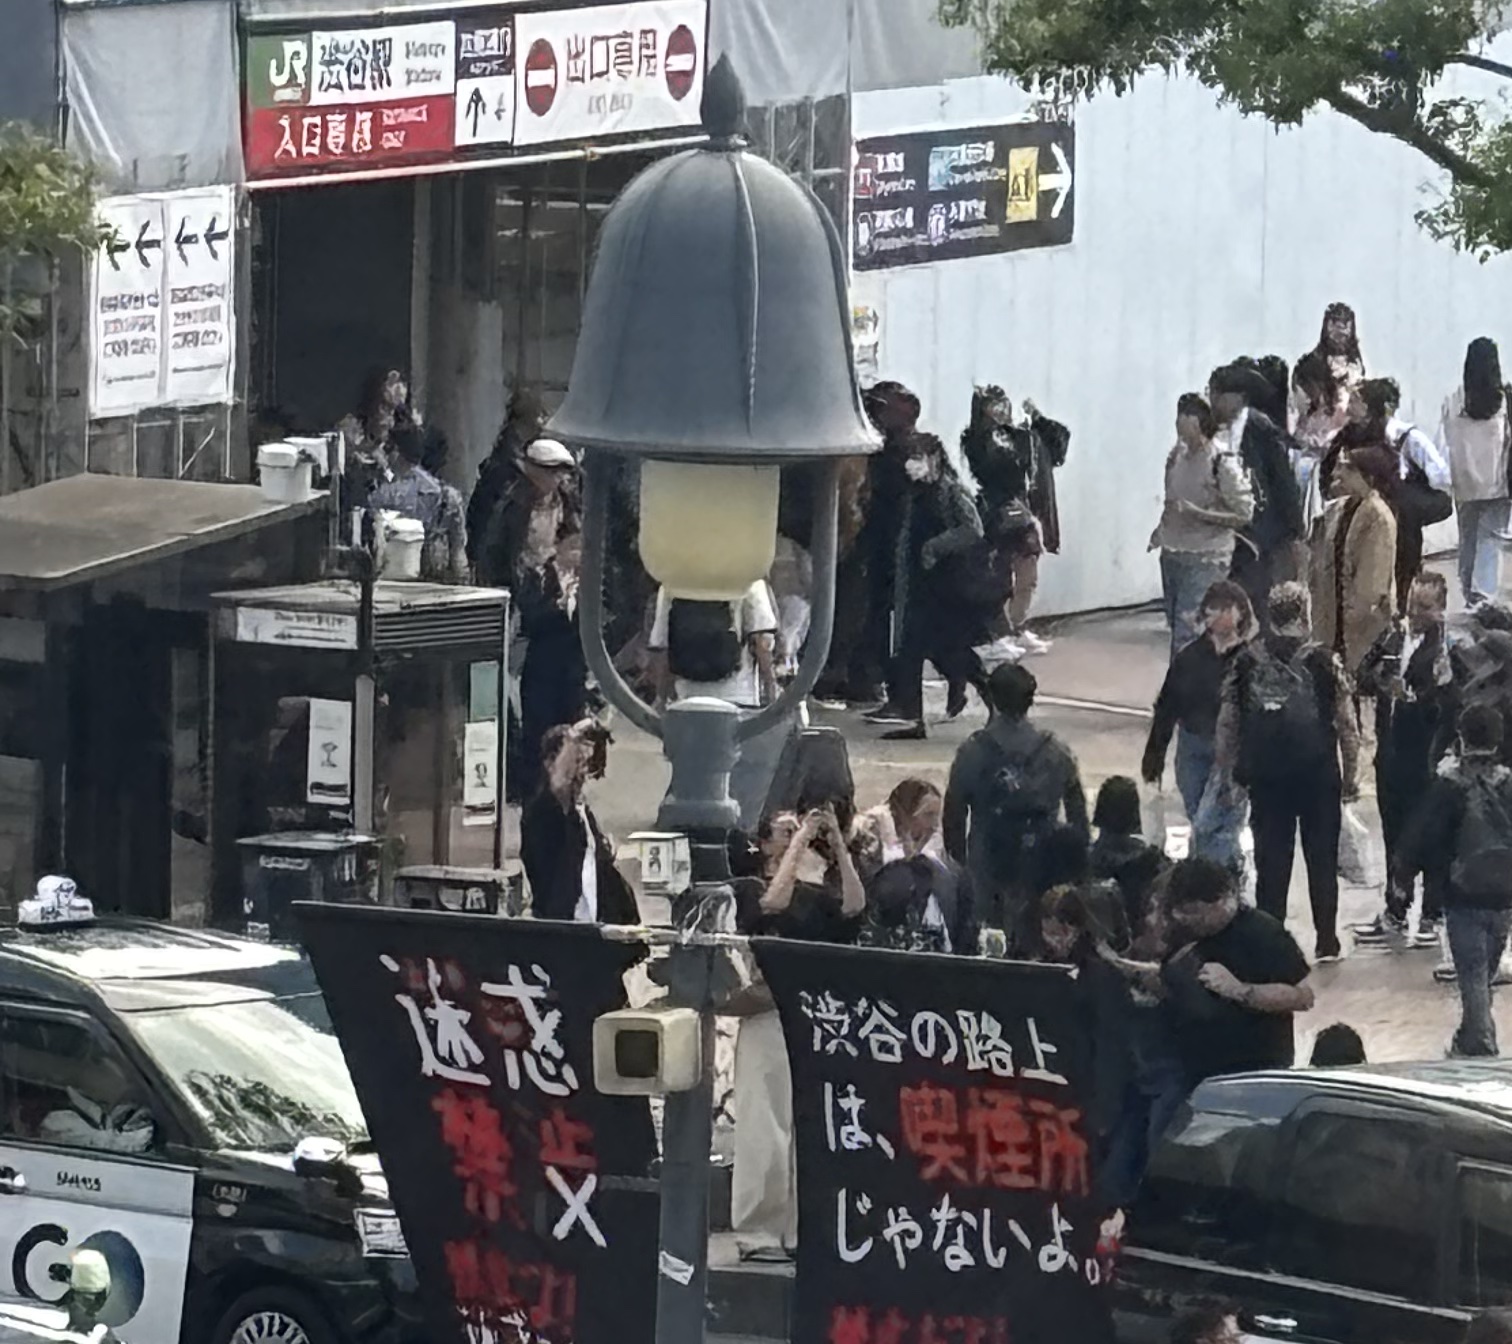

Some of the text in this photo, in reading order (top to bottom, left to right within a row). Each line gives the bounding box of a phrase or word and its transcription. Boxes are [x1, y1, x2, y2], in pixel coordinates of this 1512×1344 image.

[269, 40, 309, 89] JR
[379, 954, 580, 1096] 迷惑
[799, 990, 1069, 1085] 渋谷の路上
[837, 1187, 1101, 1285] じゃないよ。
